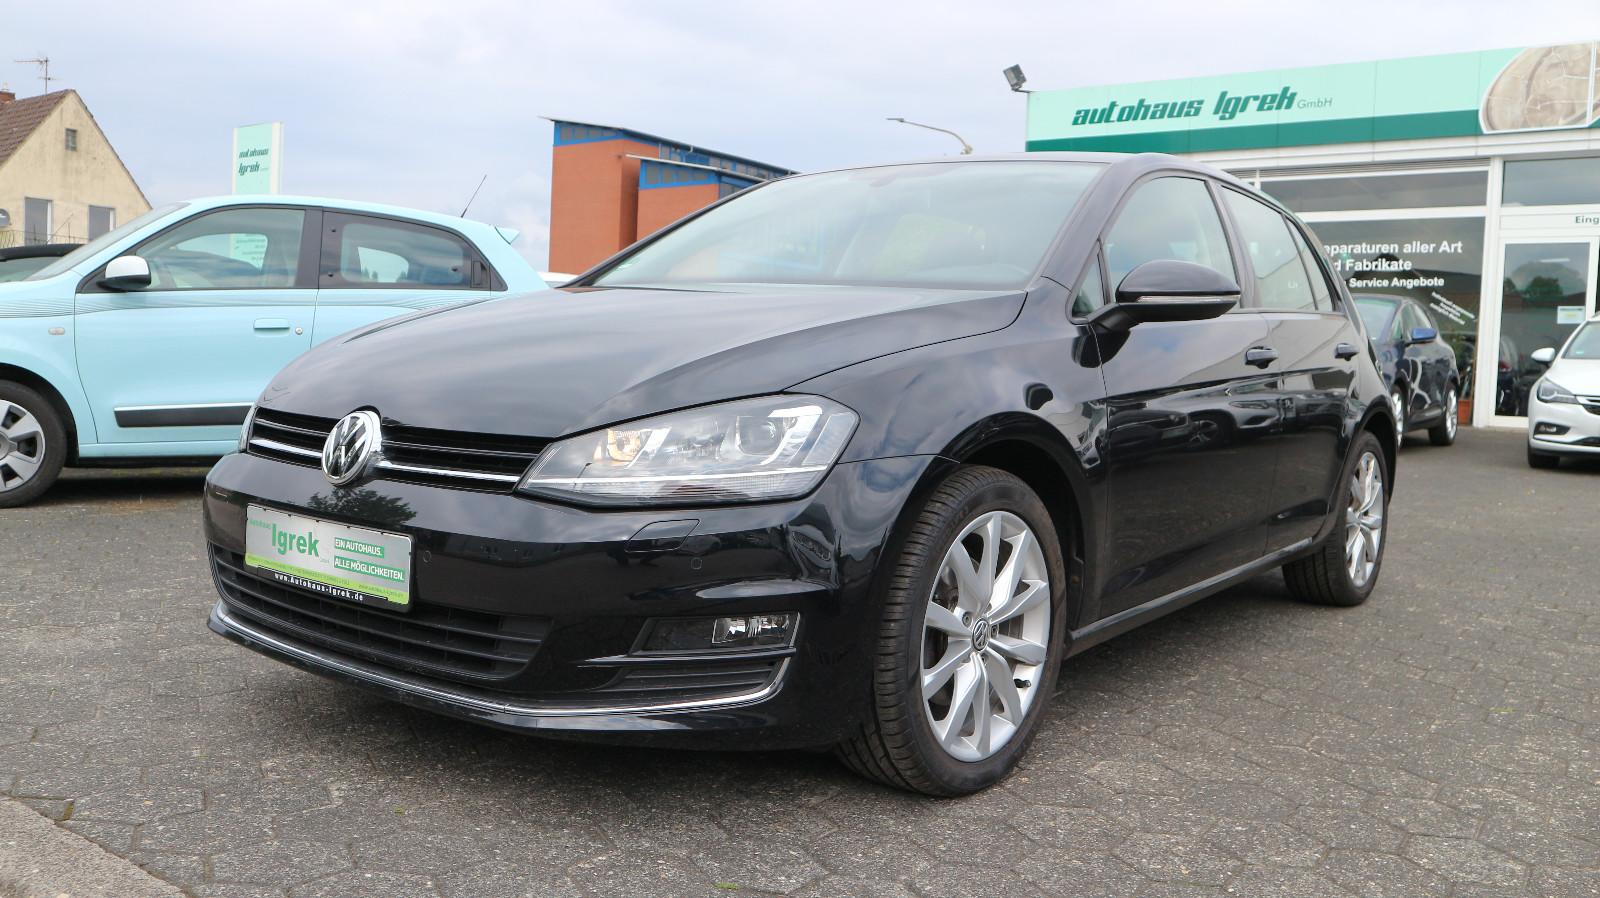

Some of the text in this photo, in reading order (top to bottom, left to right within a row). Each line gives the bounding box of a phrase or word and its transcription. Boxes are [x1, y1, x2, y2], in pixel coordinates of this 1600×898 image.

[1071, 86, 1333, 126] autohaus Igrek GmbH
[1323, 240, 1463, 257] eparaturen aller Art
[1345, 257, 1412, 272] Fabrikate
[1348, 277, 1390, 288] Service
[1391, 276, 1445, 289] Angebote
[271, 523, 319, 557] Igrek
[335, 538, 346, 548] EIN
[334, 557, 350, 571] ALLE
